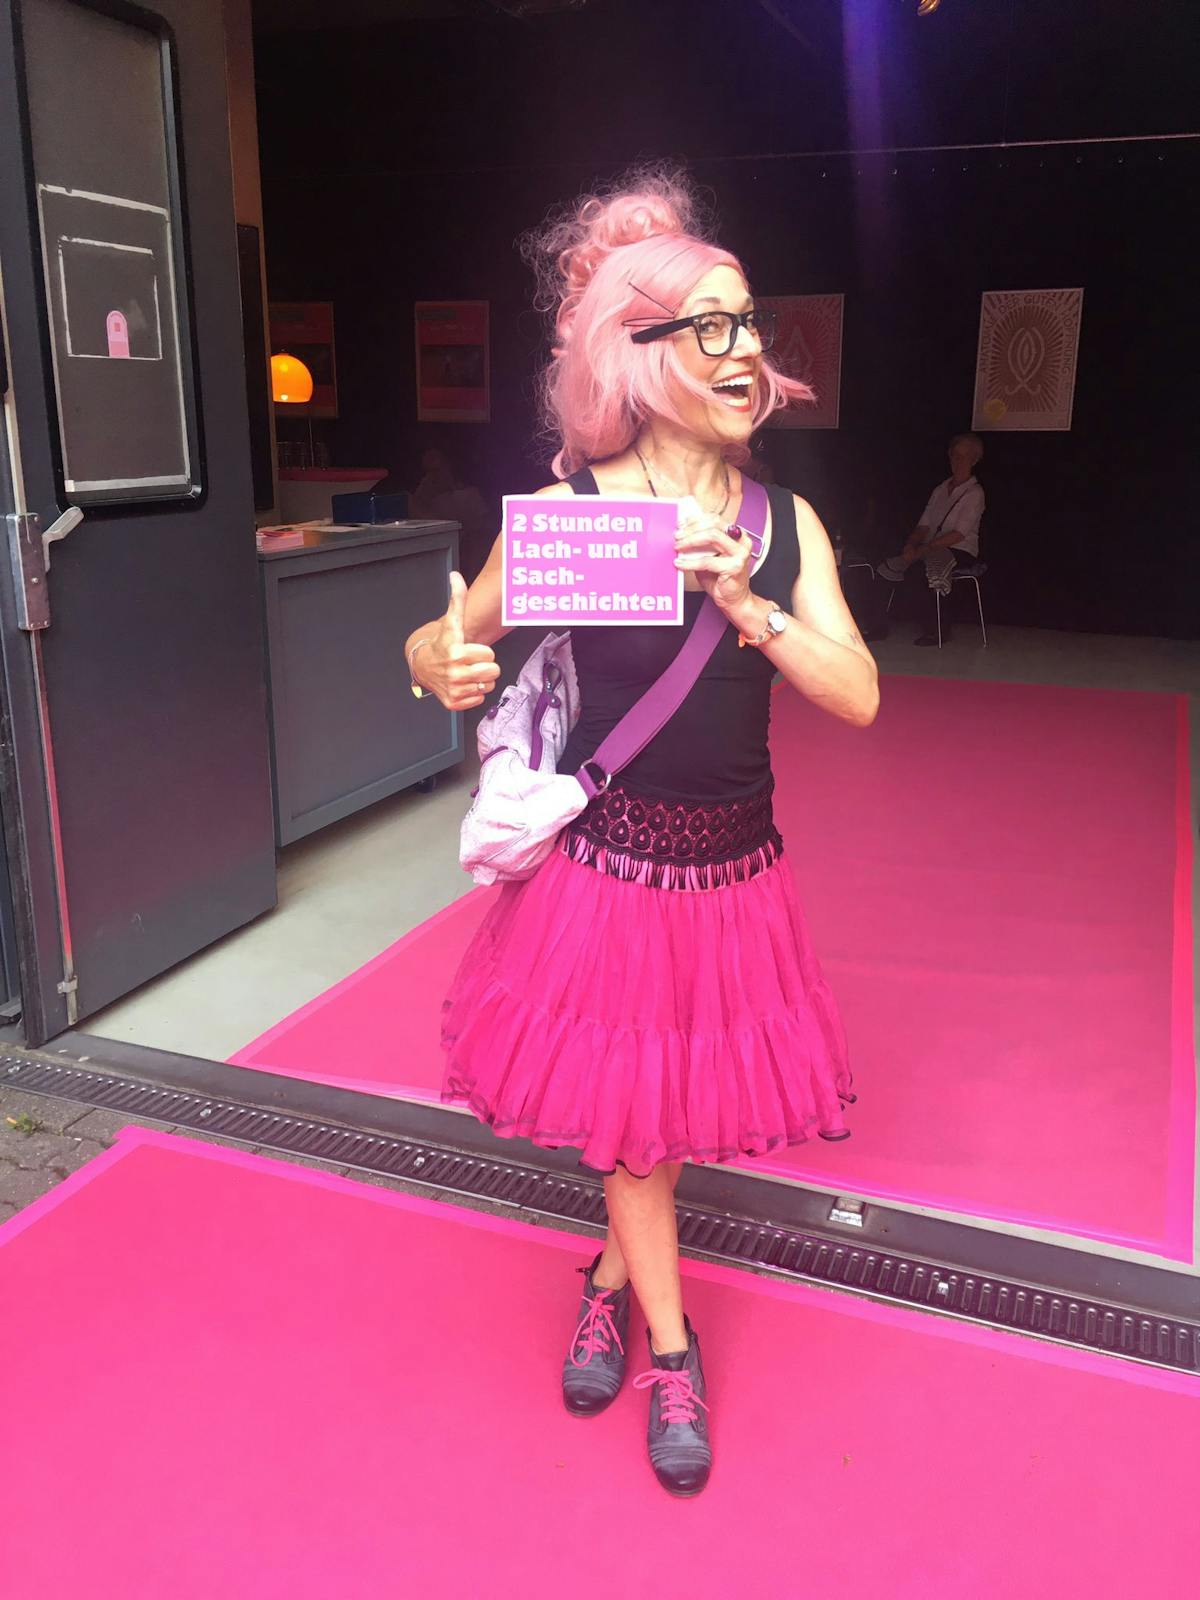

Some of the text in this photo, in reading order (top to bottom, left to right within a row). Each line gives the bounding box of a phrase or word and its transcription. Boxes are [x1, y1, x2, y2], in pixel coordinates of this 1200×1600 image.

[511, 513, 643, 533] 2 Stunden
[511, 540, 638, 559] Lach- und
[511, 566, 585, 586] Sach-
[511, 592, 673, 615] geschichten
